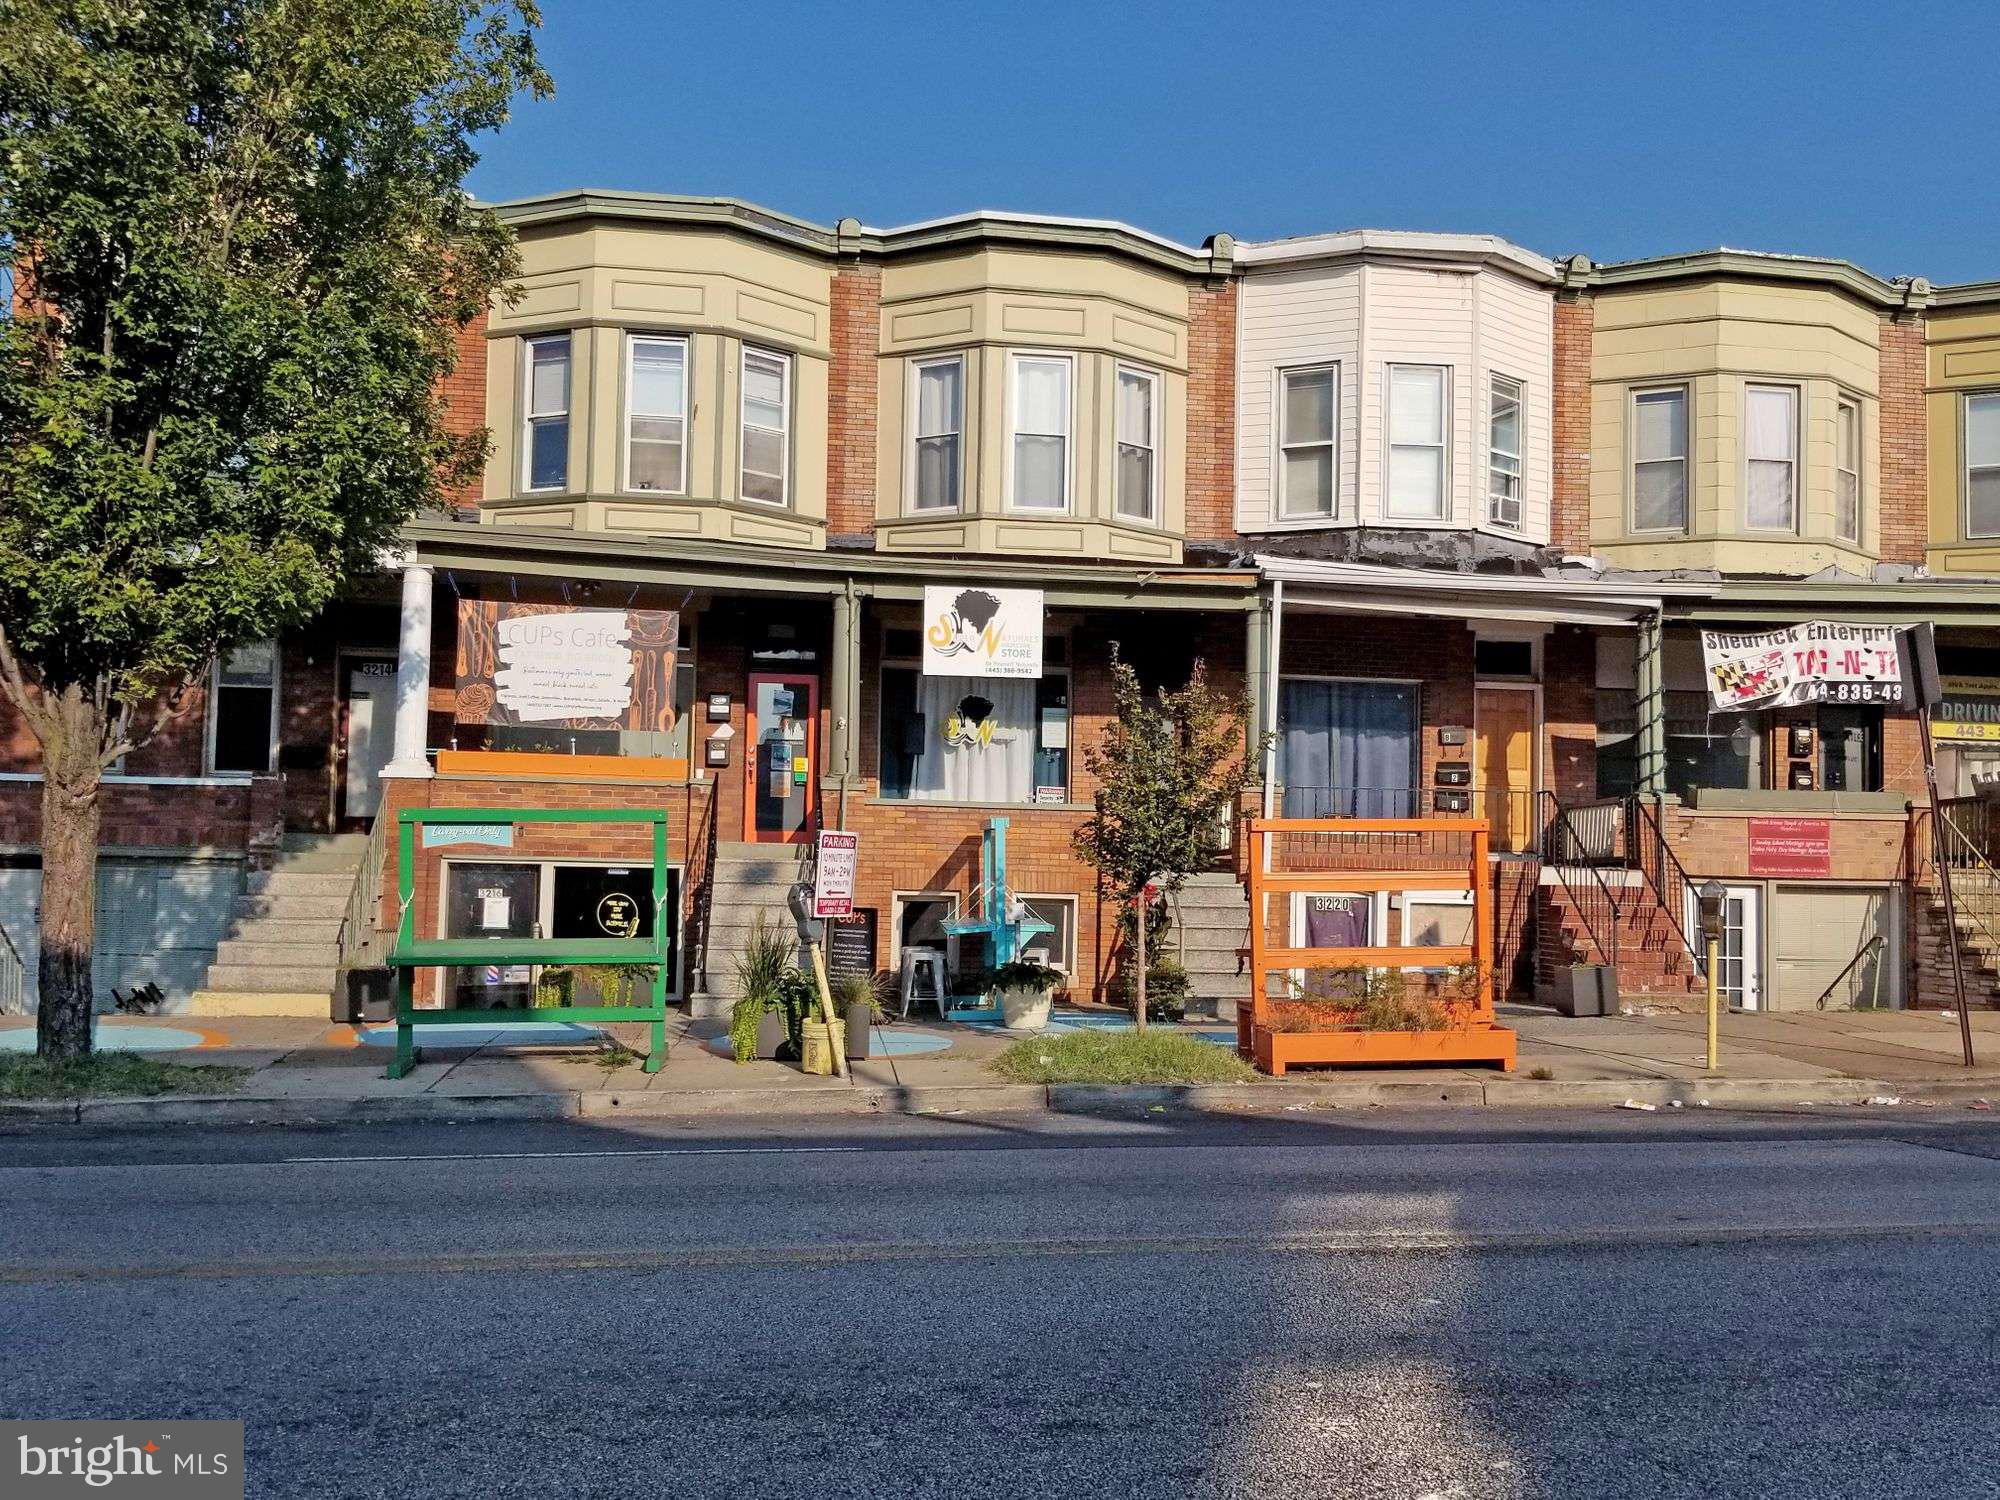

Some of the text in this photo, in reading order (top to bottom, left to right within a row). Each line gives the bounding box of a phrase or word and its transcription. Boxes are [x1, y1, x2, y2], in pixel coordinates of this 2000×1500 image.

[508, 624, 617, 648] CUPs Cafe
[1001, 648, 1032, 659] STORE
[1793, 647, 1828, 676] TAG
[363, 664, 392, 676] 3214
[1956, 725, 1985, 737] 443
[823, 835, 855, 848] PARKING
[823, 866, 851, 877] 9AM-2PM
[479, 889, 502, 897] 3216
[1317, 898, 1349, 910] 3220
